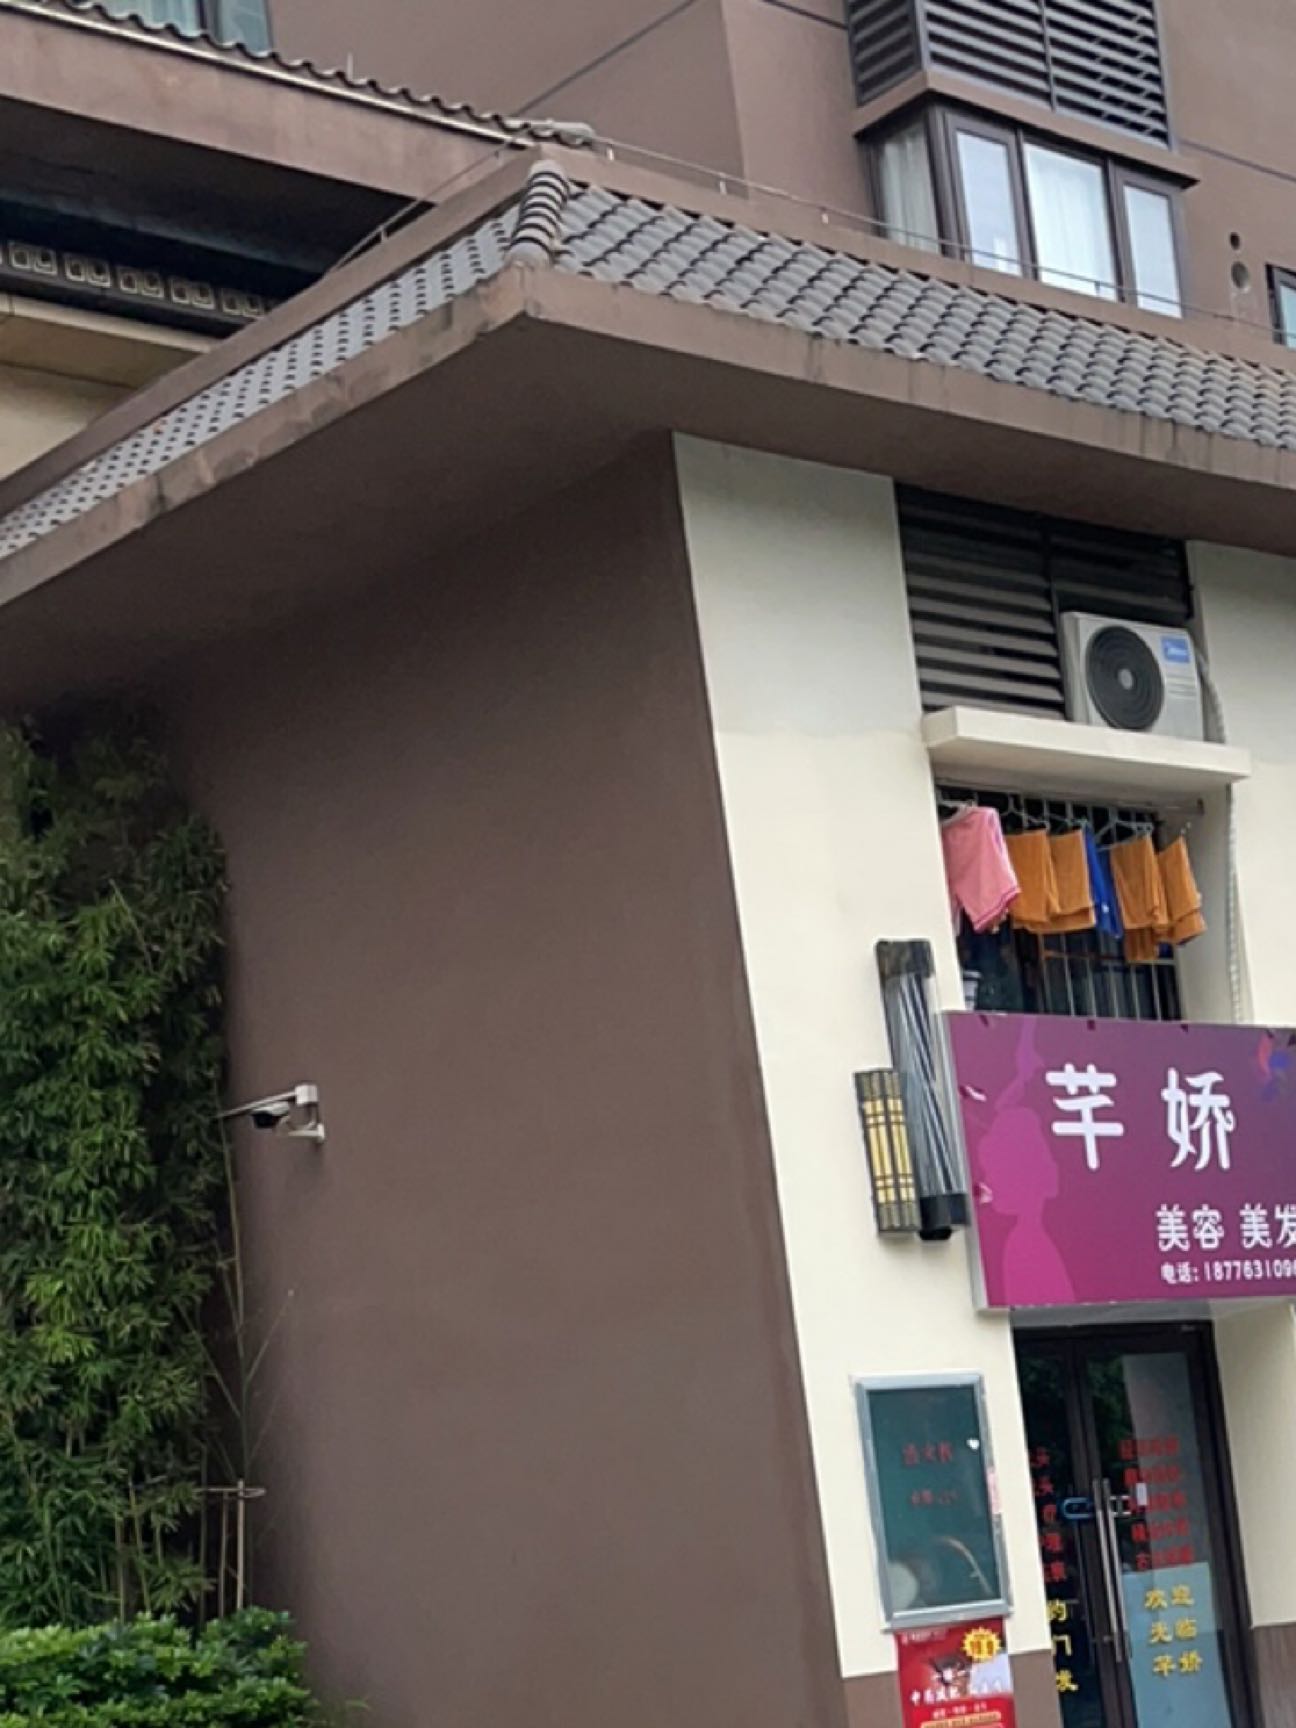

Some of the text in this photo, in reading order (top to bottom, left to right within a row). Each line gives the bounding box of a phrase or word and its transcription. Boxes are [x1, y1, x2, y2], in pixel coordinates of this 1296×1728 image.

[1156, 1202, 1225, 1252] 美容
[1143, 1585, 1195, 1610] 欢迎
[1149, 1617, 1198, 1645] 光临
